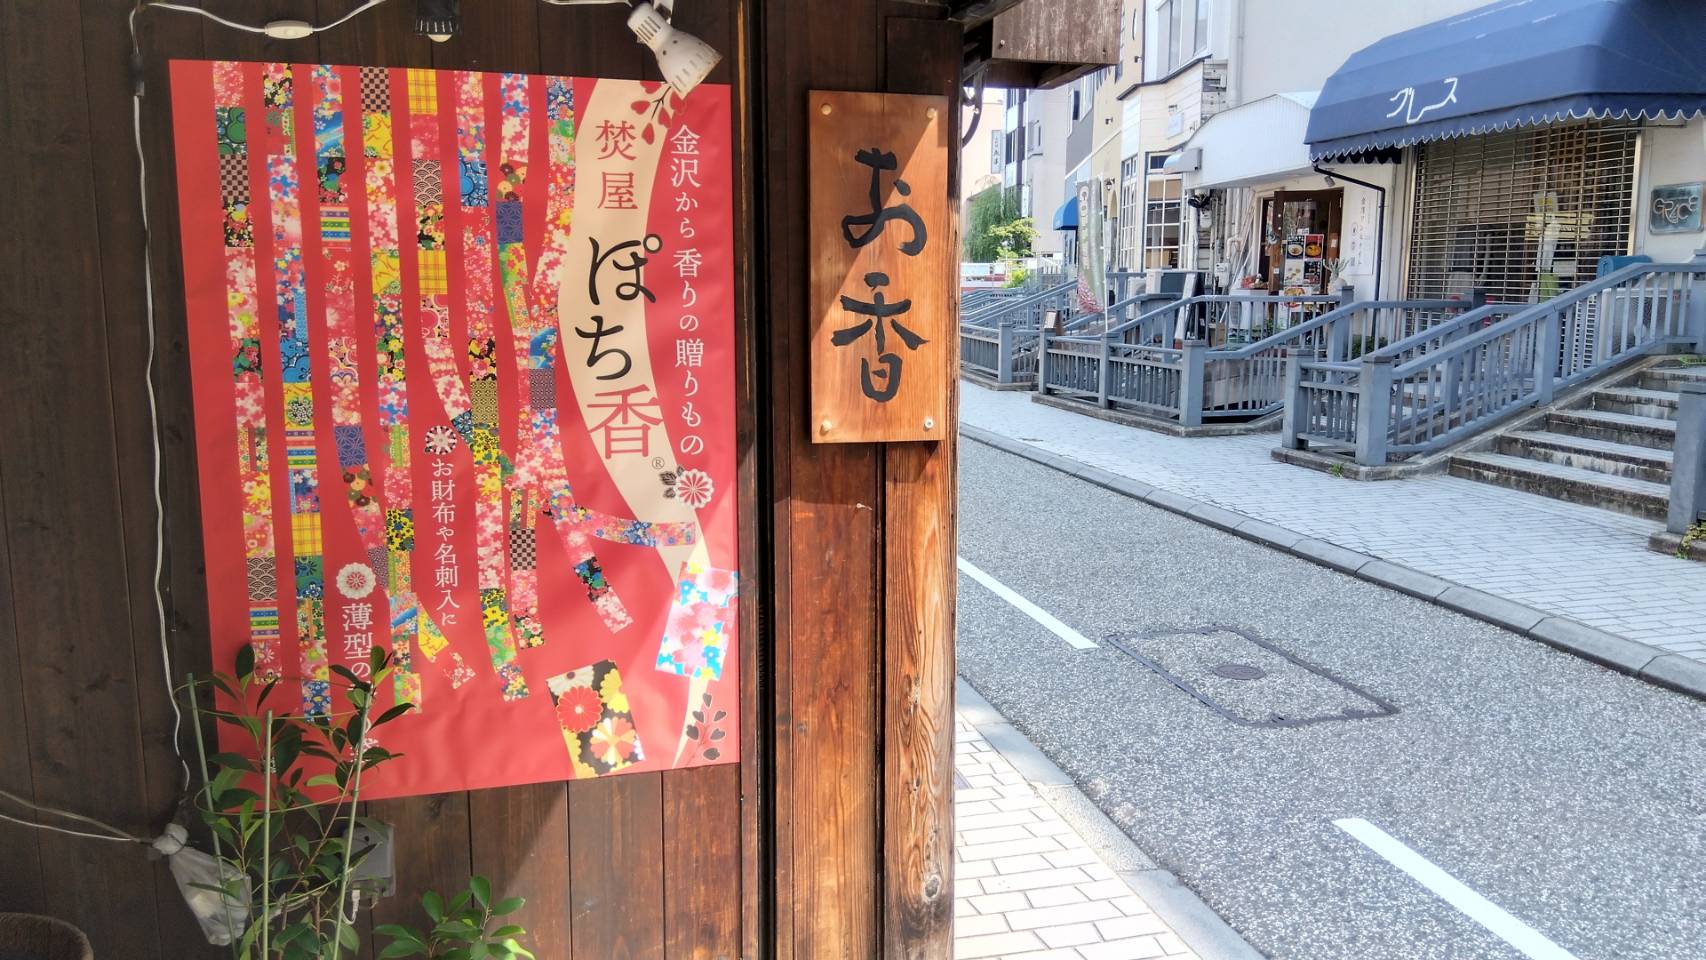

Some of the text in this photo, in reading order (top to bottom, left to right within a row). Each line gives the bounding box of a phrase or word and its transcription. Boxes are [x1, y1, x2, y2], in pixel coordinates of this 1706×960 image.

[575, 119, 664, 459] 焚屋 ぽち香
[670, 124, 705, 456] 金沢から香りの贈りもの
[831, 147, 931, 403] お香
[431, 458, 460, 626] お財布や名刺入に
